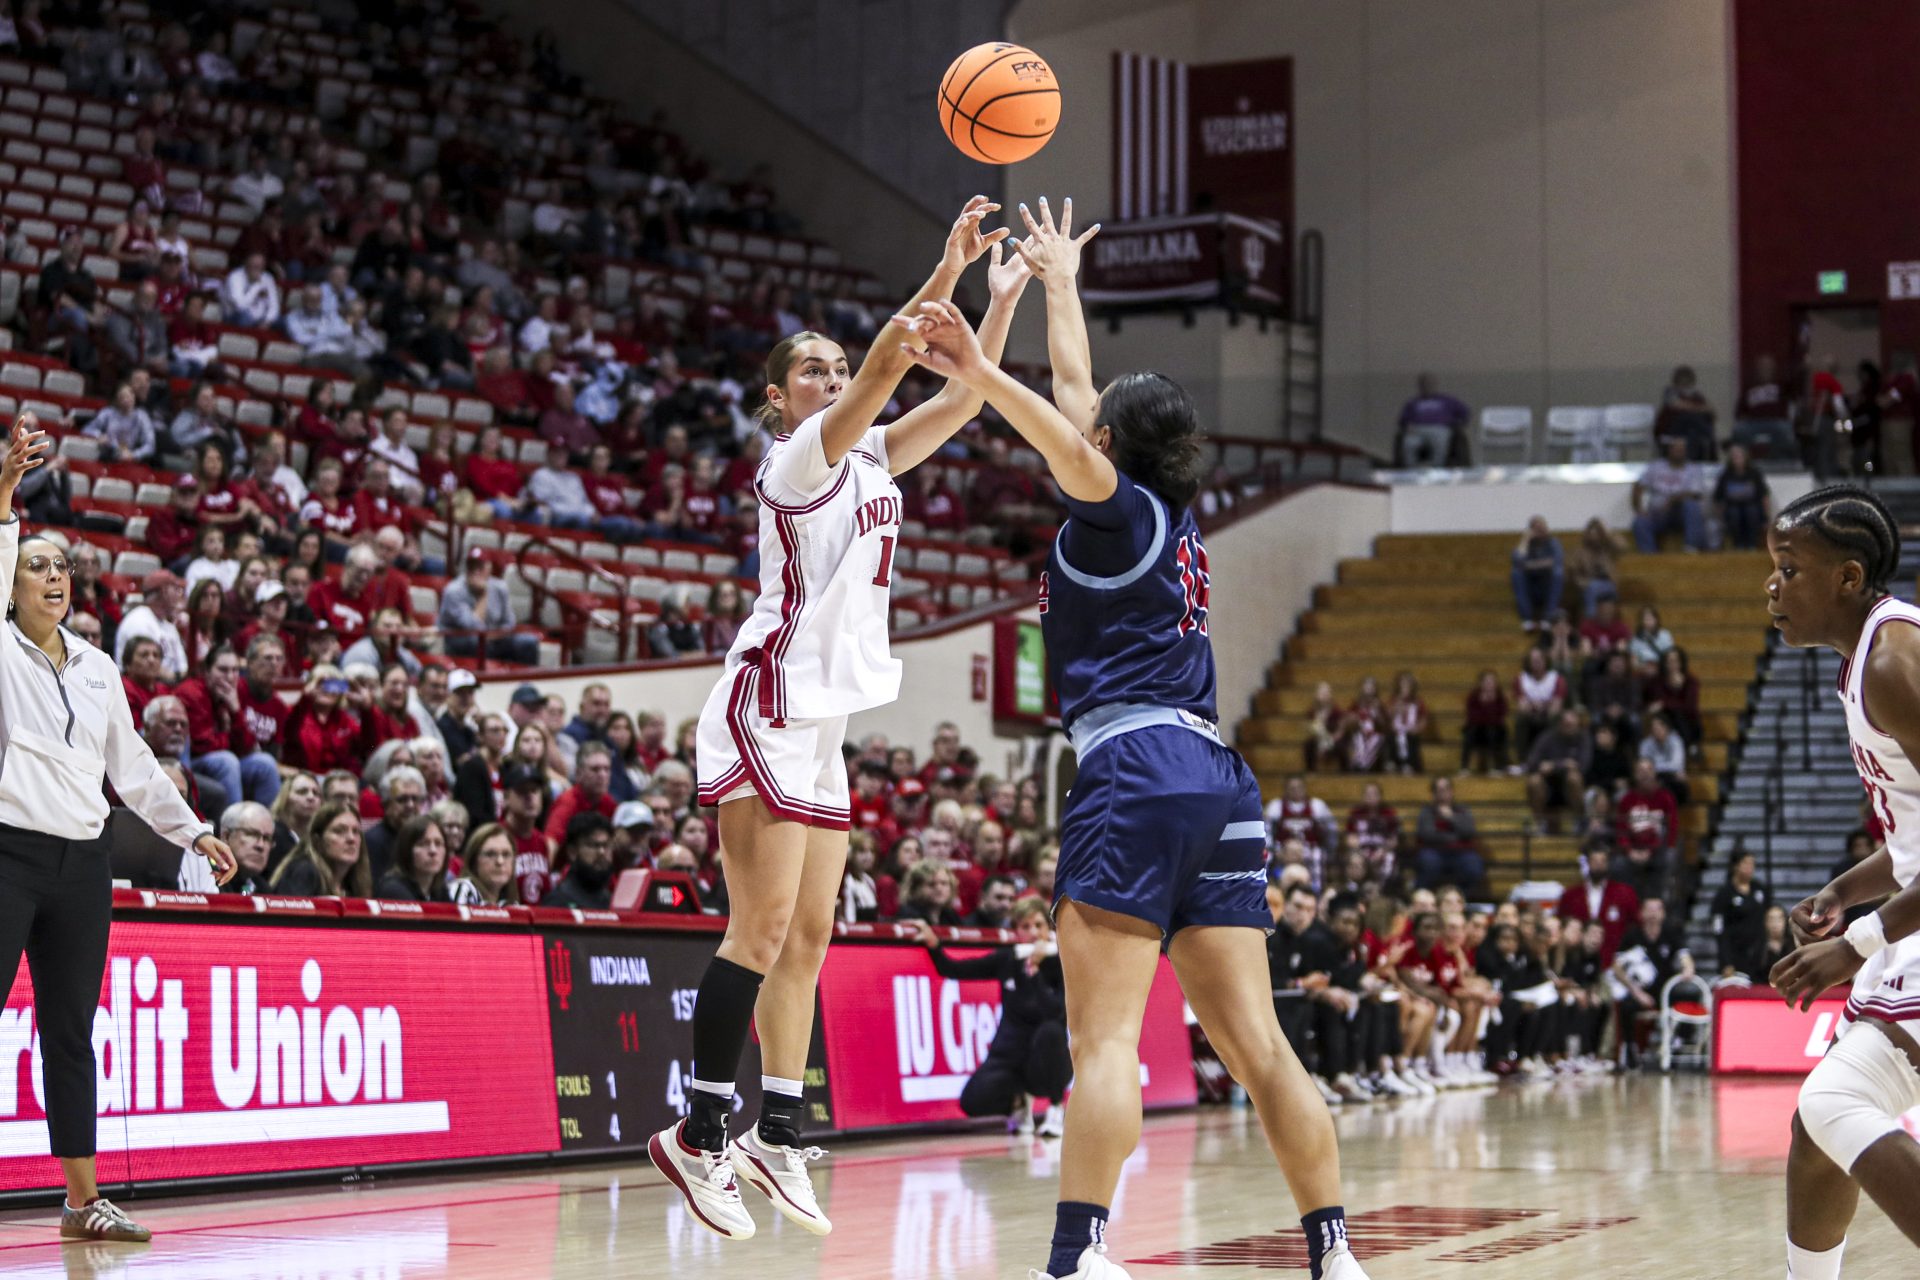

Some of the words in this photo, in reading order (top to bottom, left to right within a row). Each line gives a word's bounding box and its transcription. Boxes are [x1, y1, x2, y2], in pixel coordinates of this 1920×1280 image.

[1096, 231, 1202, 267] INDIANA
[855, 496, 904, 538] INDI
[872, 535, 894, 588] 1
[590, 956, 650, 985] INDIANA
[671, 989, 699, 1021] 1ST
[0, 955, 189, 1117] rdit
[209, 957, 404, 1109] Union
[617, 1010, 640, 1053] 11
[893, 975, 935, 1077] IU
[939, 977, 1002, 1074] Cre
[556, 1075, 592, 1097] FOULS
[606, 1071, 617, 1100] 1
[560, 1117, 583, 1139] TOL
[608, 1113, 621, 1142] 4
